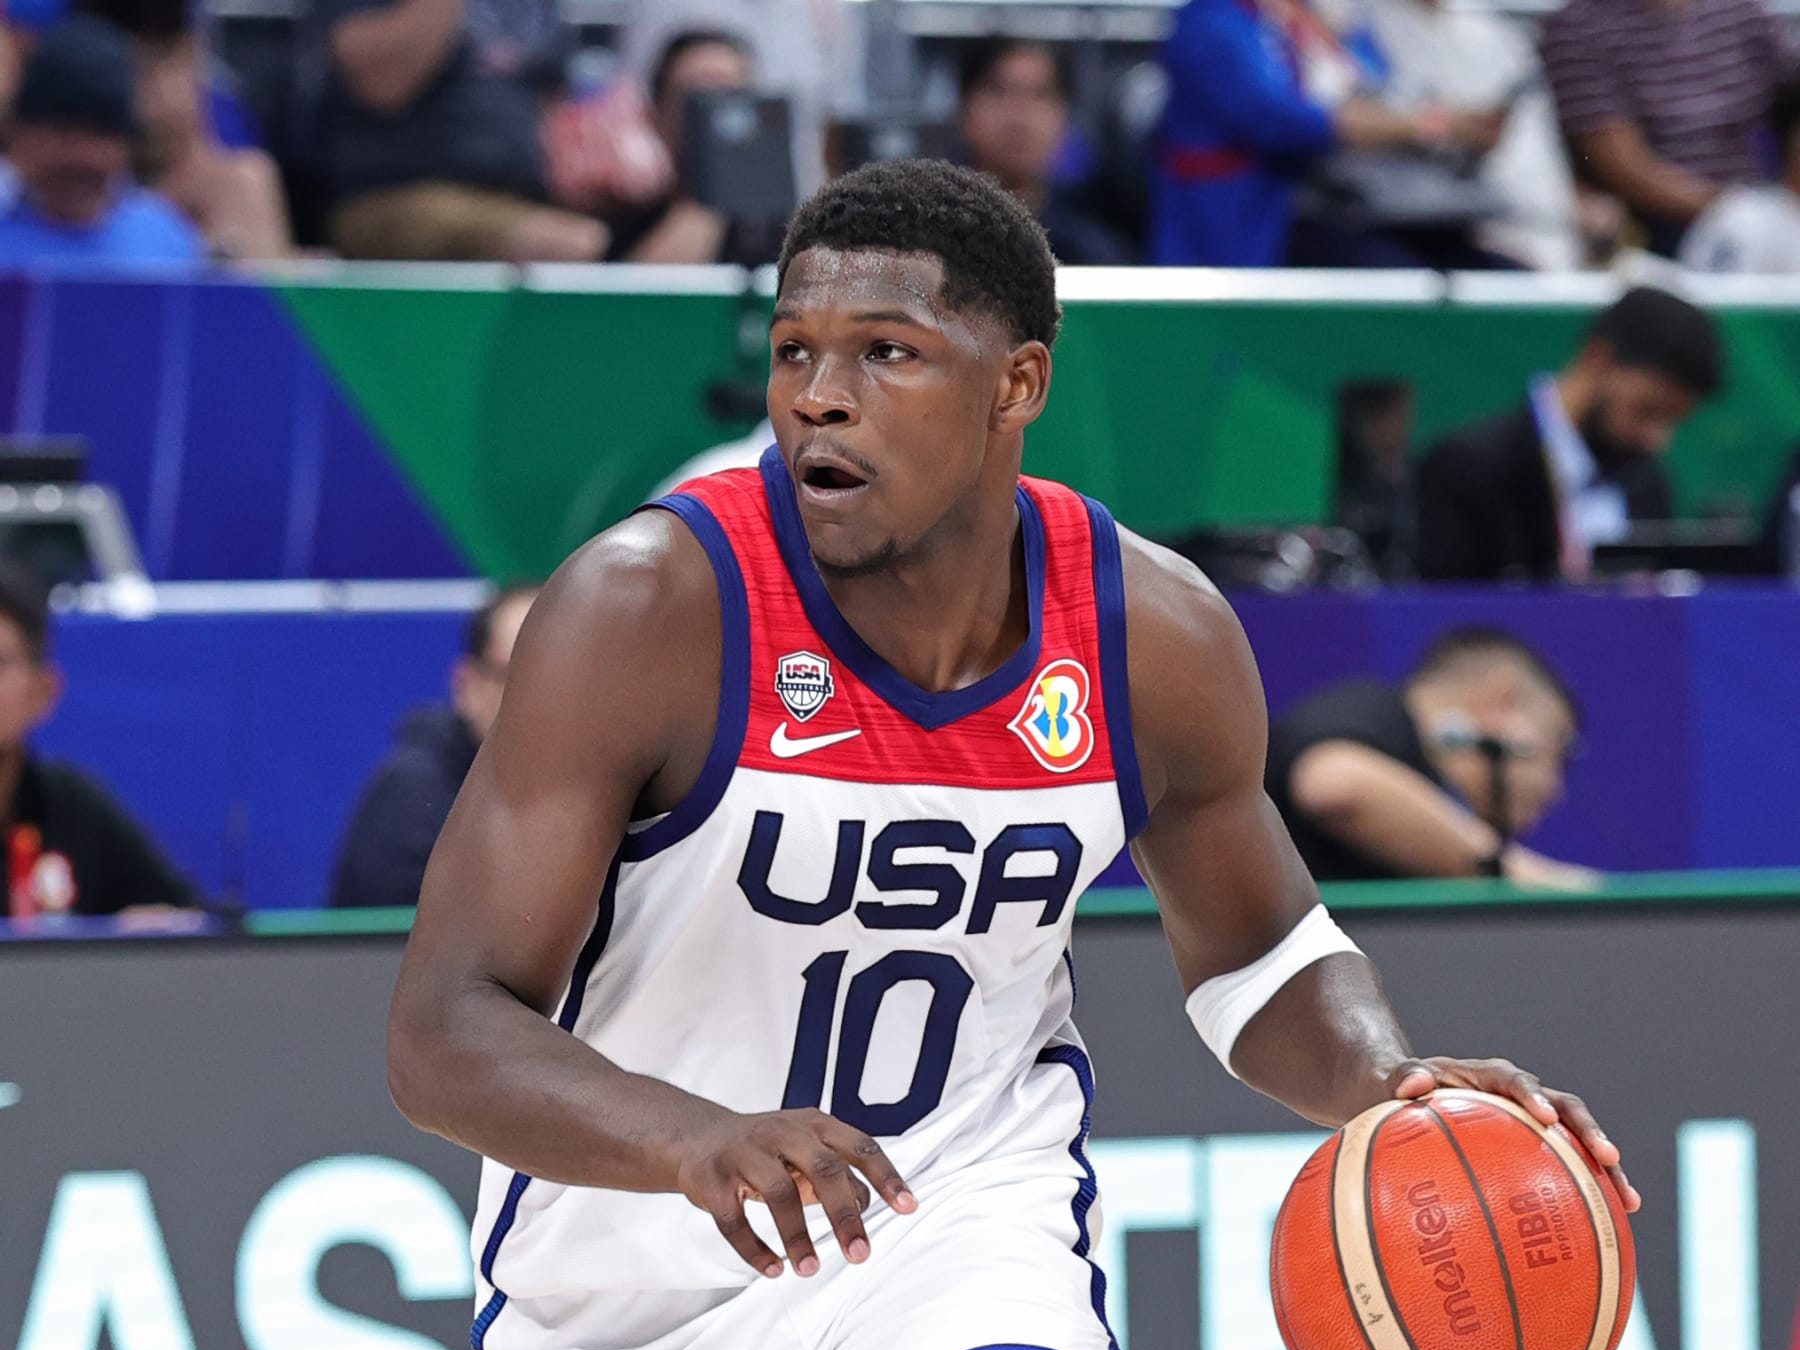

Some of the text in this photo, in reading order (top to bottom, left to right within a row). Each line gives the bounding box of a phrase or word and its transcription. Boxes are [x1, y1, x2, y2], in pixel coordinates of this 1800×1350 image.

[778, 684, 829, 693] BASKETBALL
[785, 664, 821, 681] USA
[737, 810, 1083, 935] USA
[781, 950, 975, 1137] 10
[1408, 1180, 1481, 1335] molten
[1508, 1191, 1558, 1269] FIBA
[1541, 1187, 1573, 1261] APPROVED
